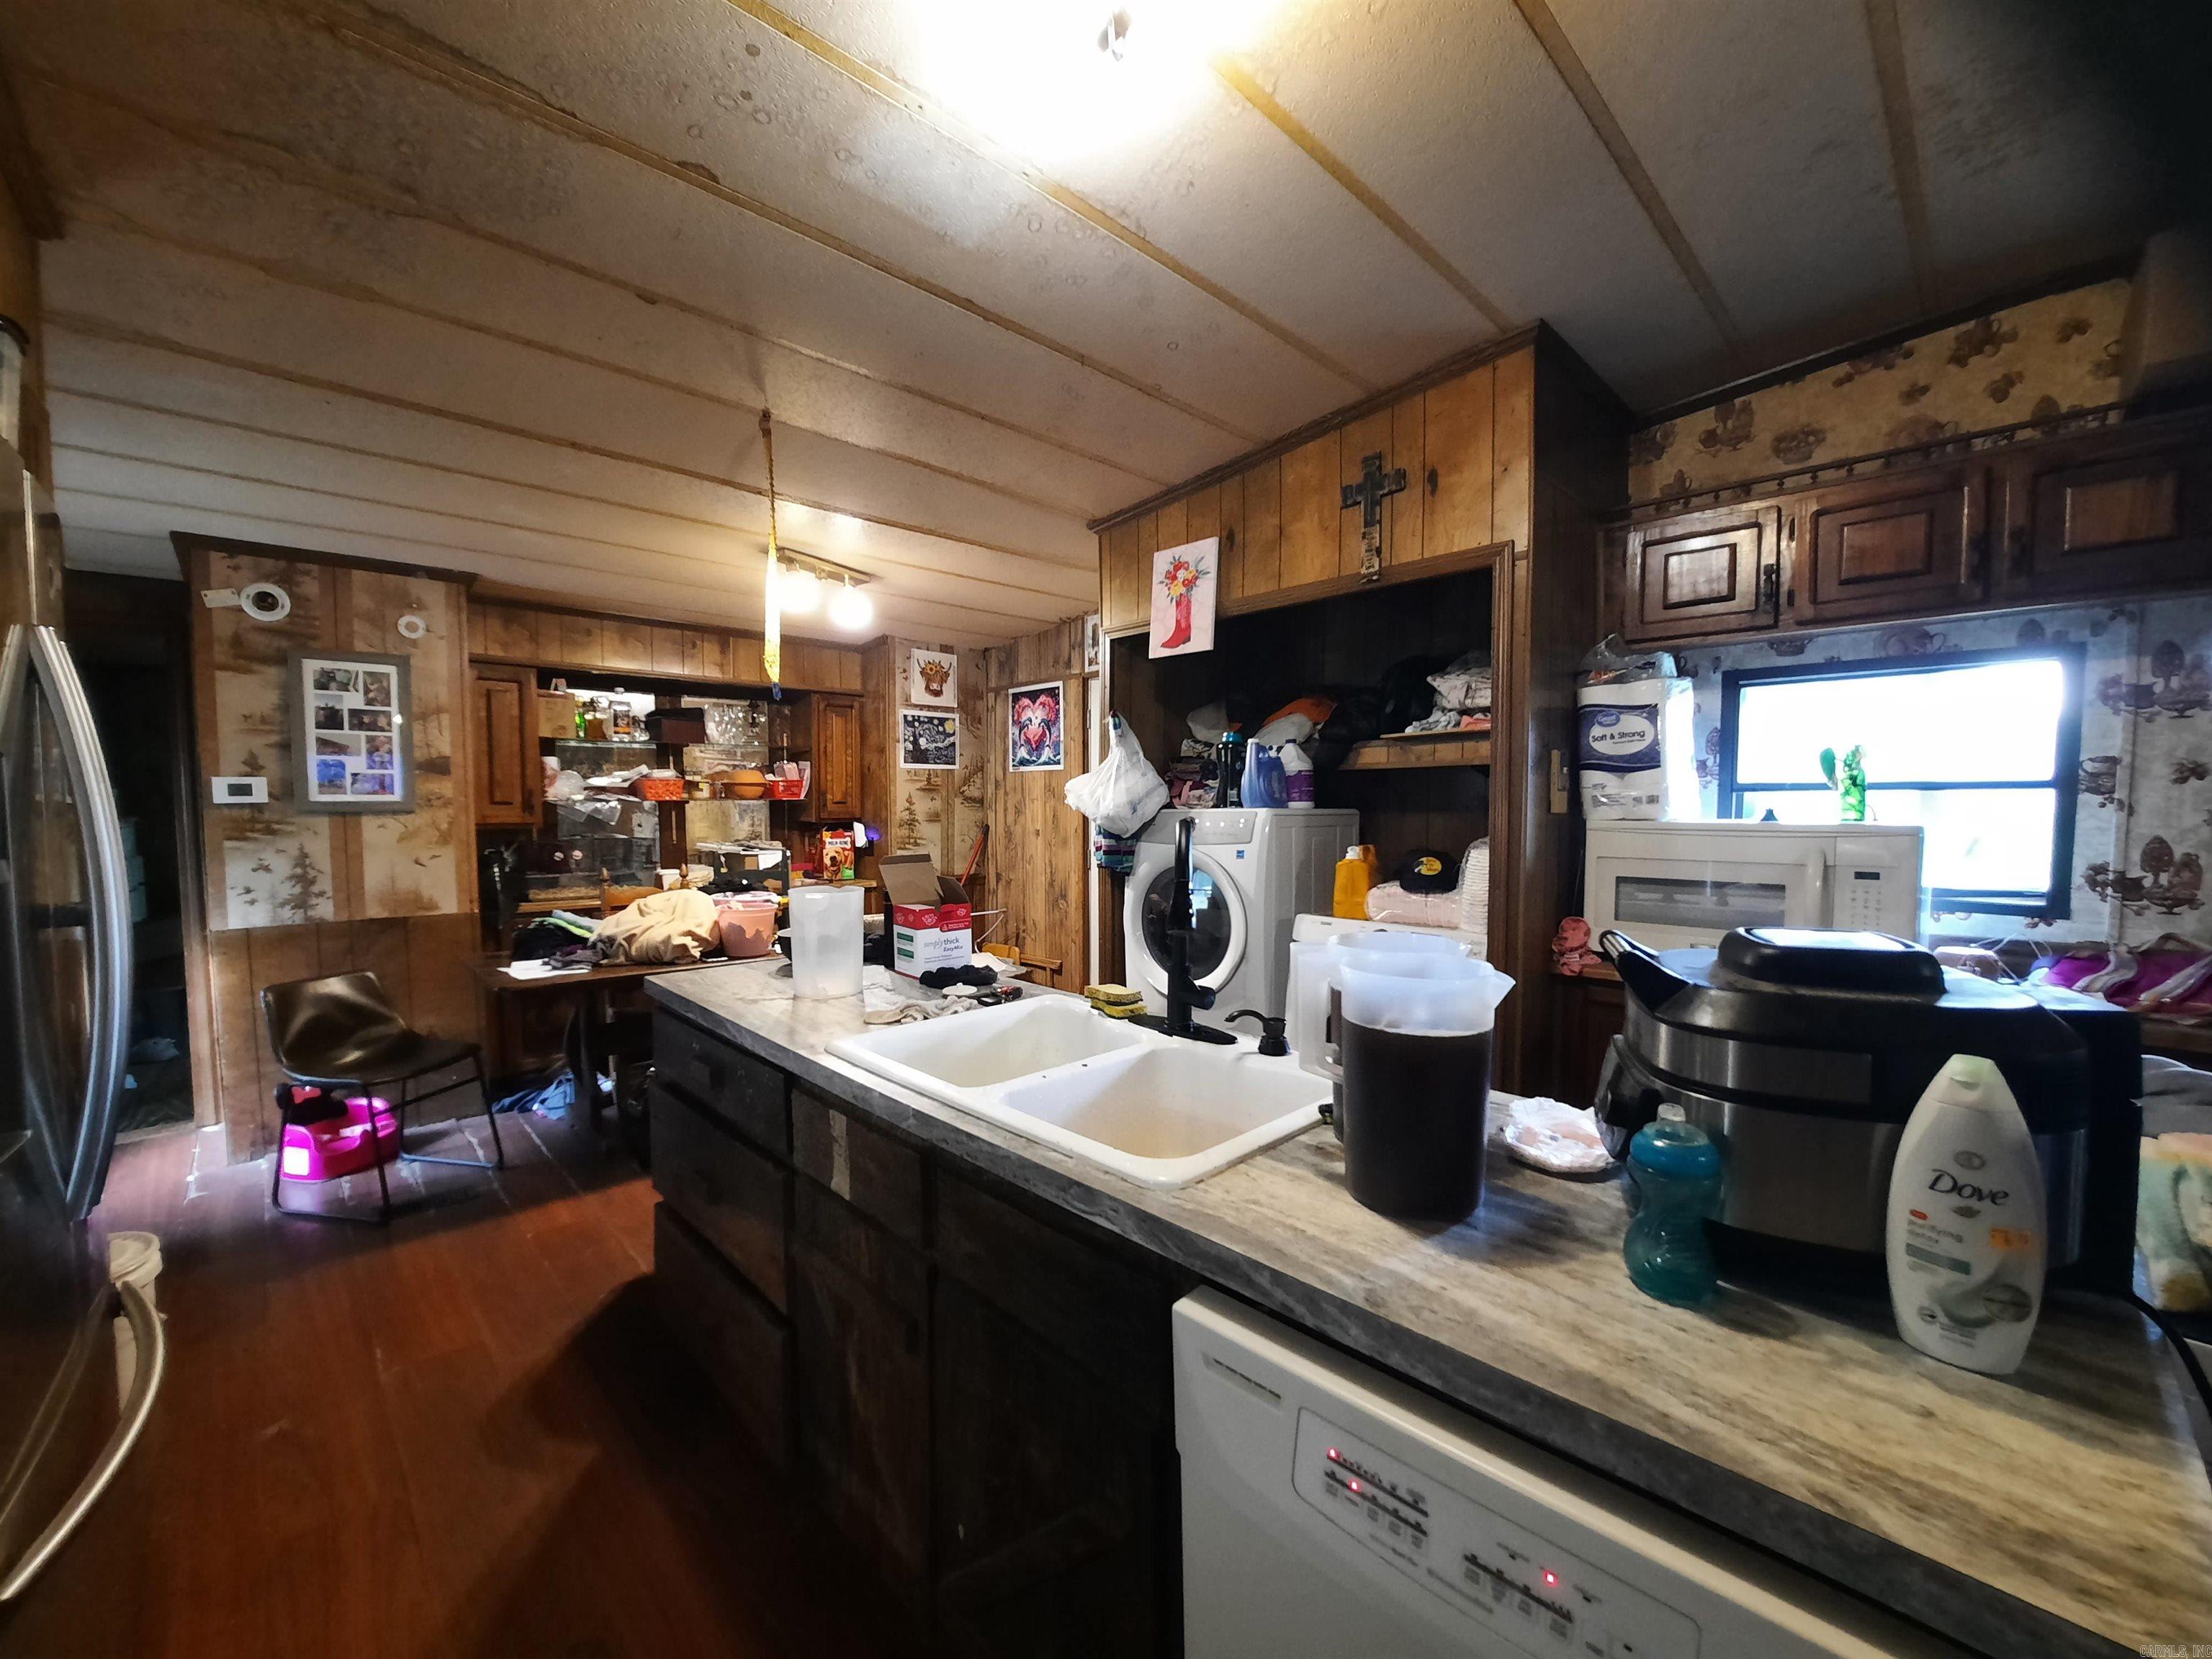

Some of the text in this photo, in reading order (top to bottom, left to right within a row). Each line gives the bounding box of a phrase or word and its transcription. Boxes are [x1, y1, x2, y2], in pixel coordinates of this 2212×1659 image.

[1591, 734, 1607, 742] Soft
[1617, 730, 1645, 739] Strong
[1928, 1168, 2010, 1206] Dove
